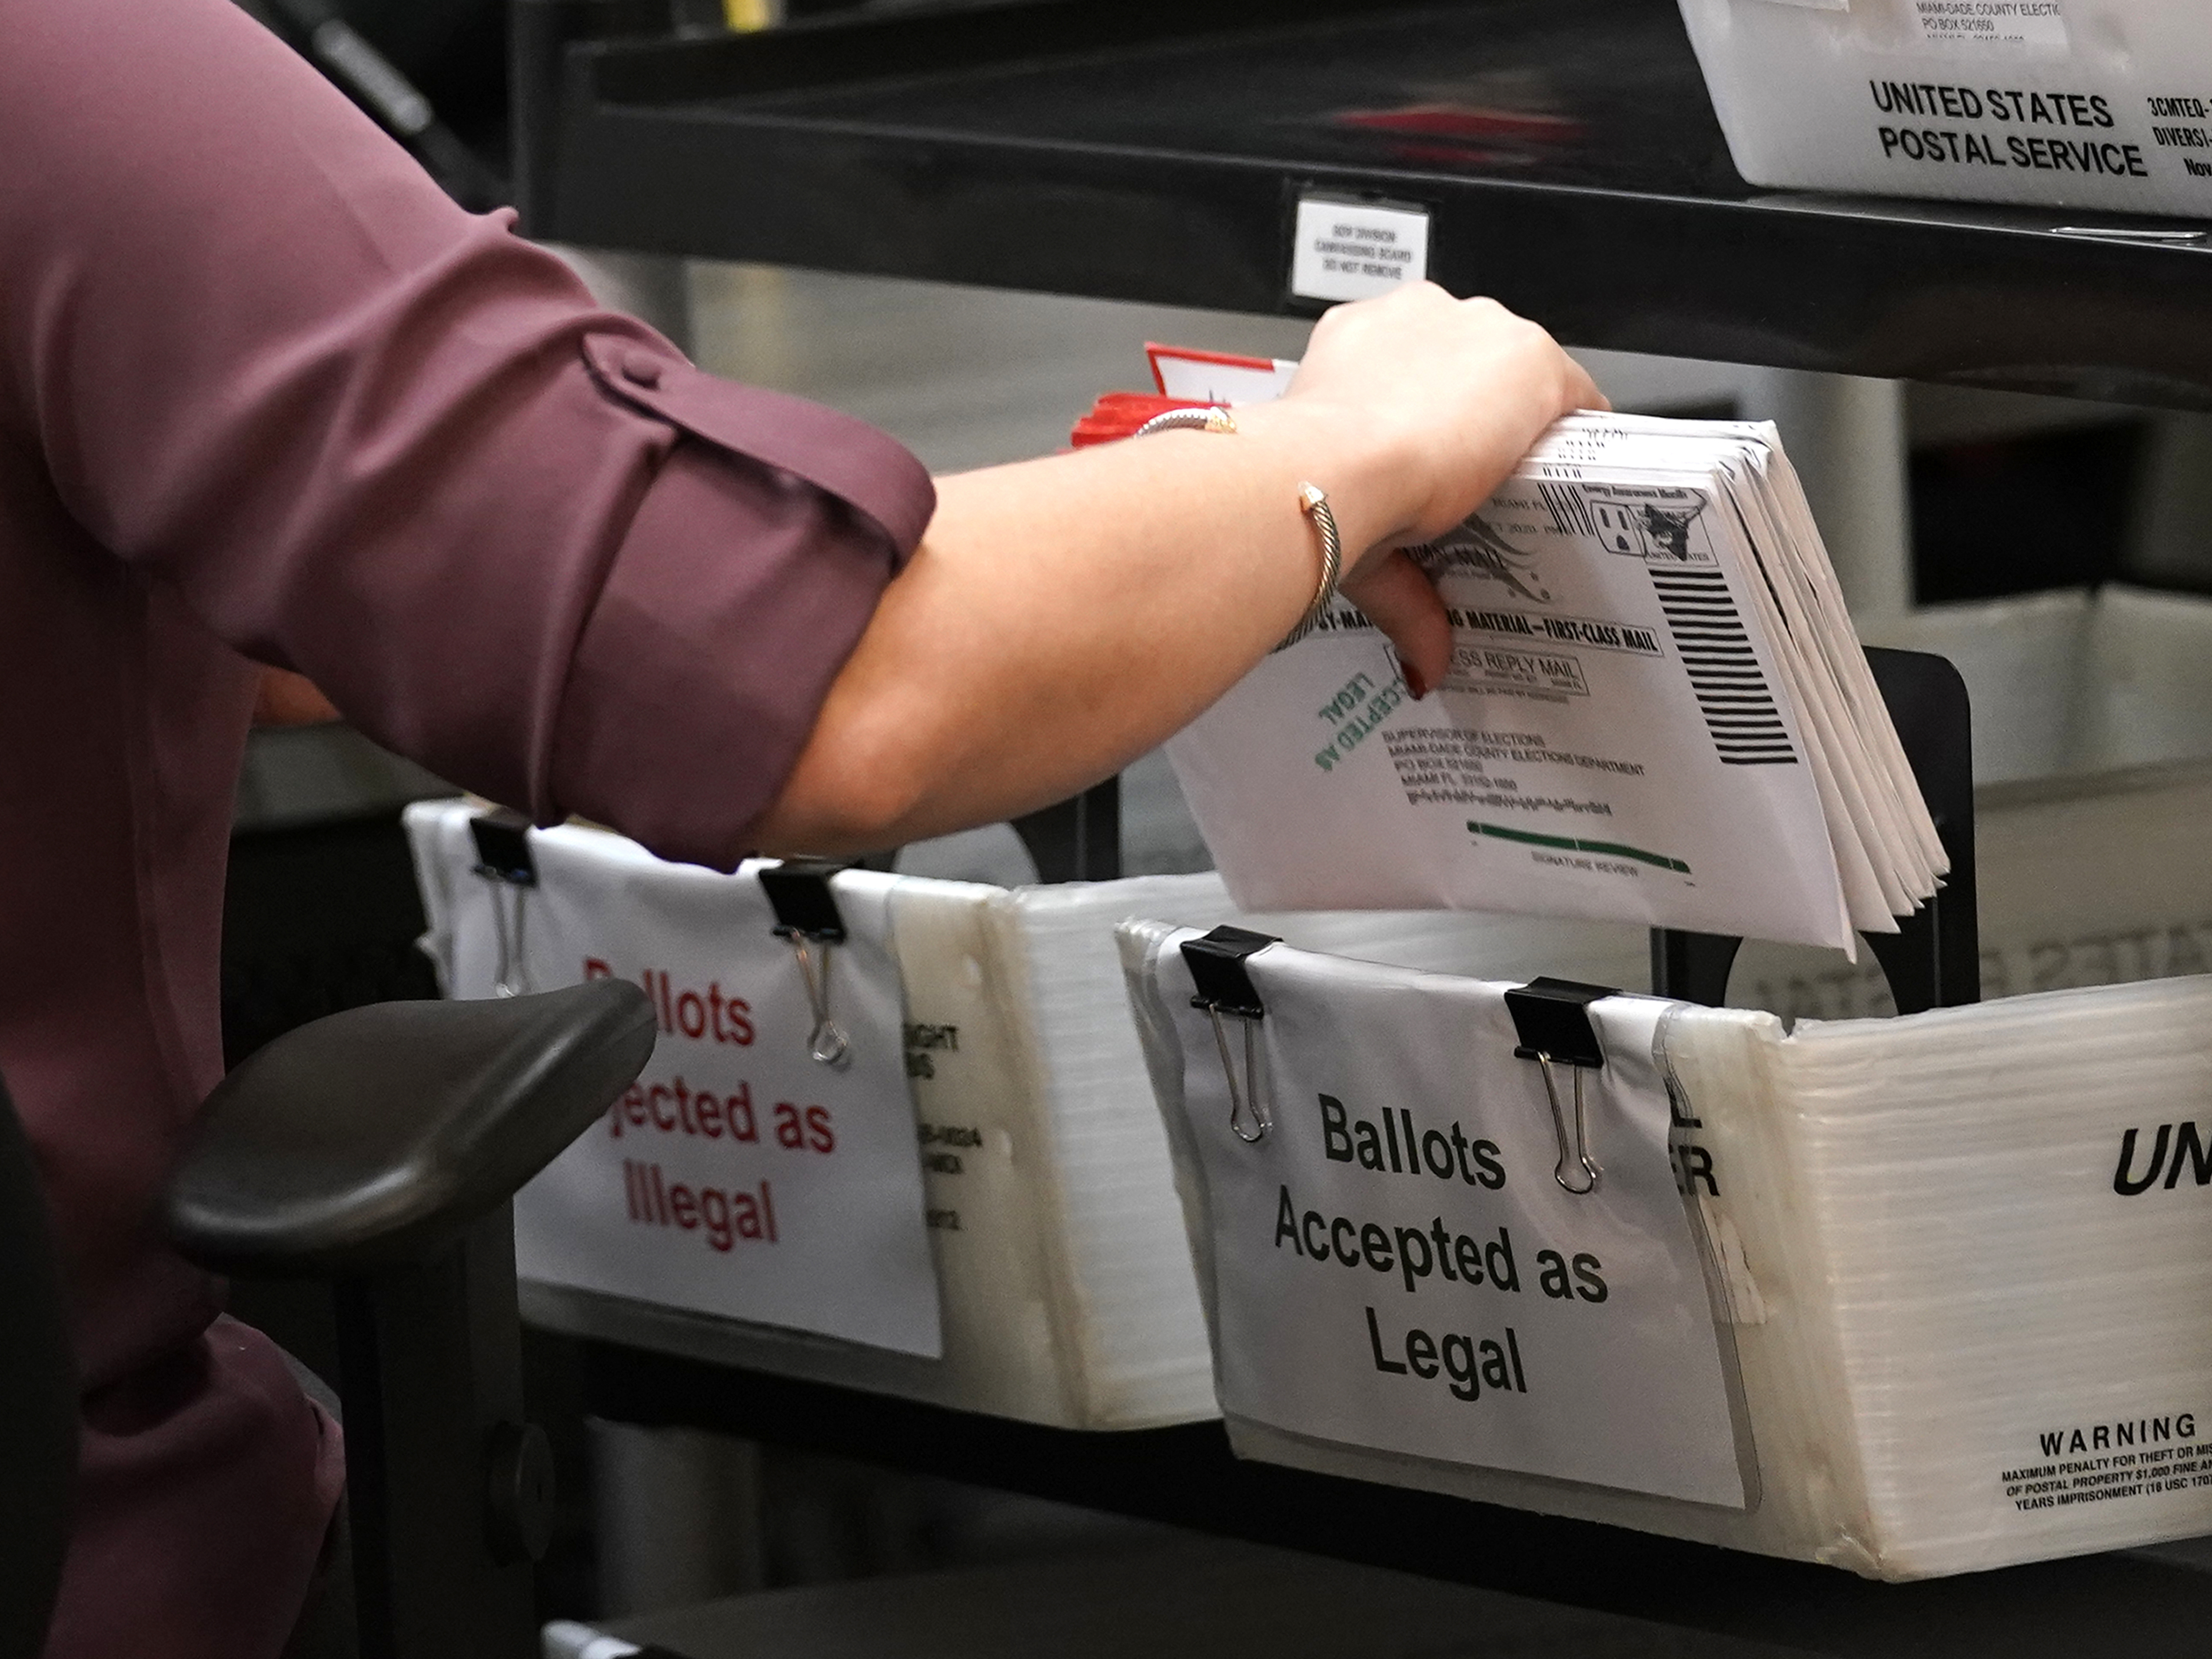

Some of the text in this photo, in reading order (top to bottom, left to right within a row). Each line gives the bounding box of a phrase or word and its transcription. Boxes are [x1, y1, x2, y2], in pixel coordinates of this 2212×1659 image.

[1916, 2, 1975, 15] MIAMI-DADE
[1975, 3, 2018, 16] COUNTY
[1921, 18, 1937, 29] PO
[1938, 18, 1960, 30] BOX
[1870, 79, 2114, 127] UNITED STATES
[1878, 127, 2148, 177] POSTAL SERVICE
[1621, 627, 1659, 653] MAIL
[1484, 651, 1535, 674] REPLY
[1538, 657, 1577, 679] MAIL
[773, 1099, 837, 1155] as
[1318, 1092, 1508, 1191] Ballots
[2113, 1122, 2212, 1196] UN
[623, 1158, 780, 1253] Illegal
[1274, 1184, 1610, 1304] Accepted as
[1365, 1305, 1528, 1404] Legal
[2040, 1413, 2196, 1457] WARNING
[2002, 1465, 2056, 1482] MAXIMUM
[2058, 1458, 2110, 1475] PENALTY
[2113, 1454, 2136, 1468] FOR
[2138, 1449, 2174, 1464] THEFT
[2177, 1446, 2193, 1459] OR
[2006, 1485, 2023, 1497] OF
[2024, 1480, 2069, 1494] POSTAL
[2073, 1471, 2133, 1488] PROPERTY
[2173, 1461, 2198, 1475] FINE
[2015, 1495, 2054, 1511] YEARS
[2057, 1484, 2143, 1505] IMPRISONMENT
[2165, 1478, 2188, 1491] USC
